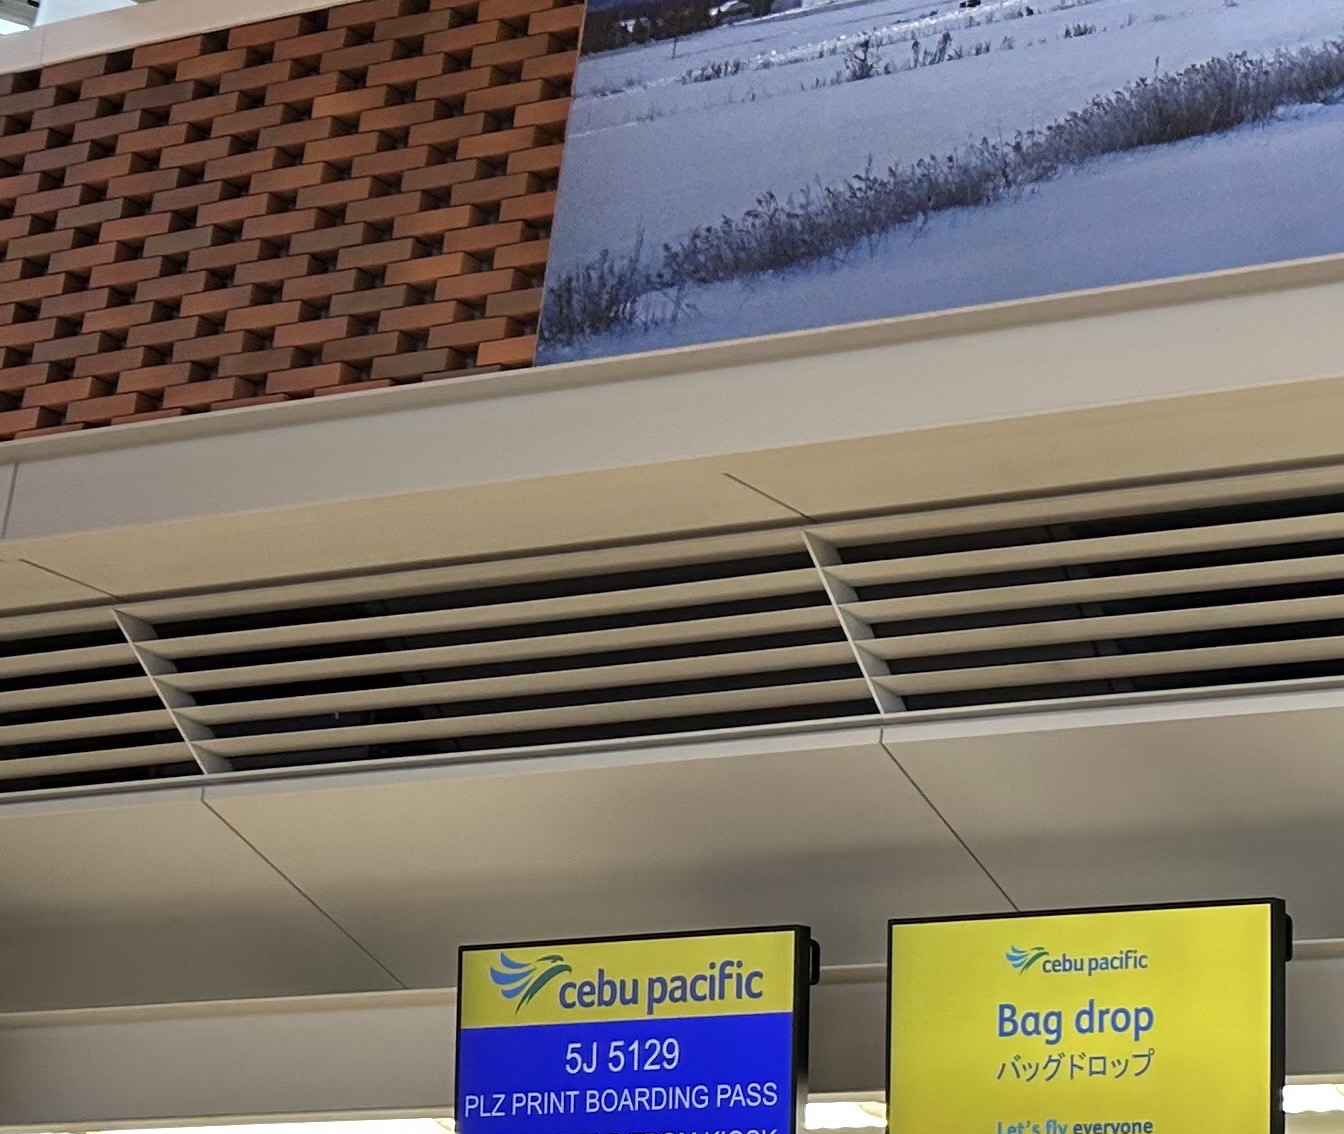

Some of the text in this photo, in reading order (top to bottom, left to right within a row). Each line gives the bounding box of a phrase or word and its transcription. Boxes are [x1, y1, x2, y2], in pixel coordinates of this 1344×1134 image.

[1042, 950, 1148, 976] cebu pacific
[559, 960, 763, 1015] cebu pacific
[997, 998, 1154, 1045] Bag drop
[565, 1038, 680, 1074] 5J 5129
[997, 1048, 1156, 1082] バッグドロップ
[465, 1082, 778, 1118] PLZ PRINT BOARDING PASS
